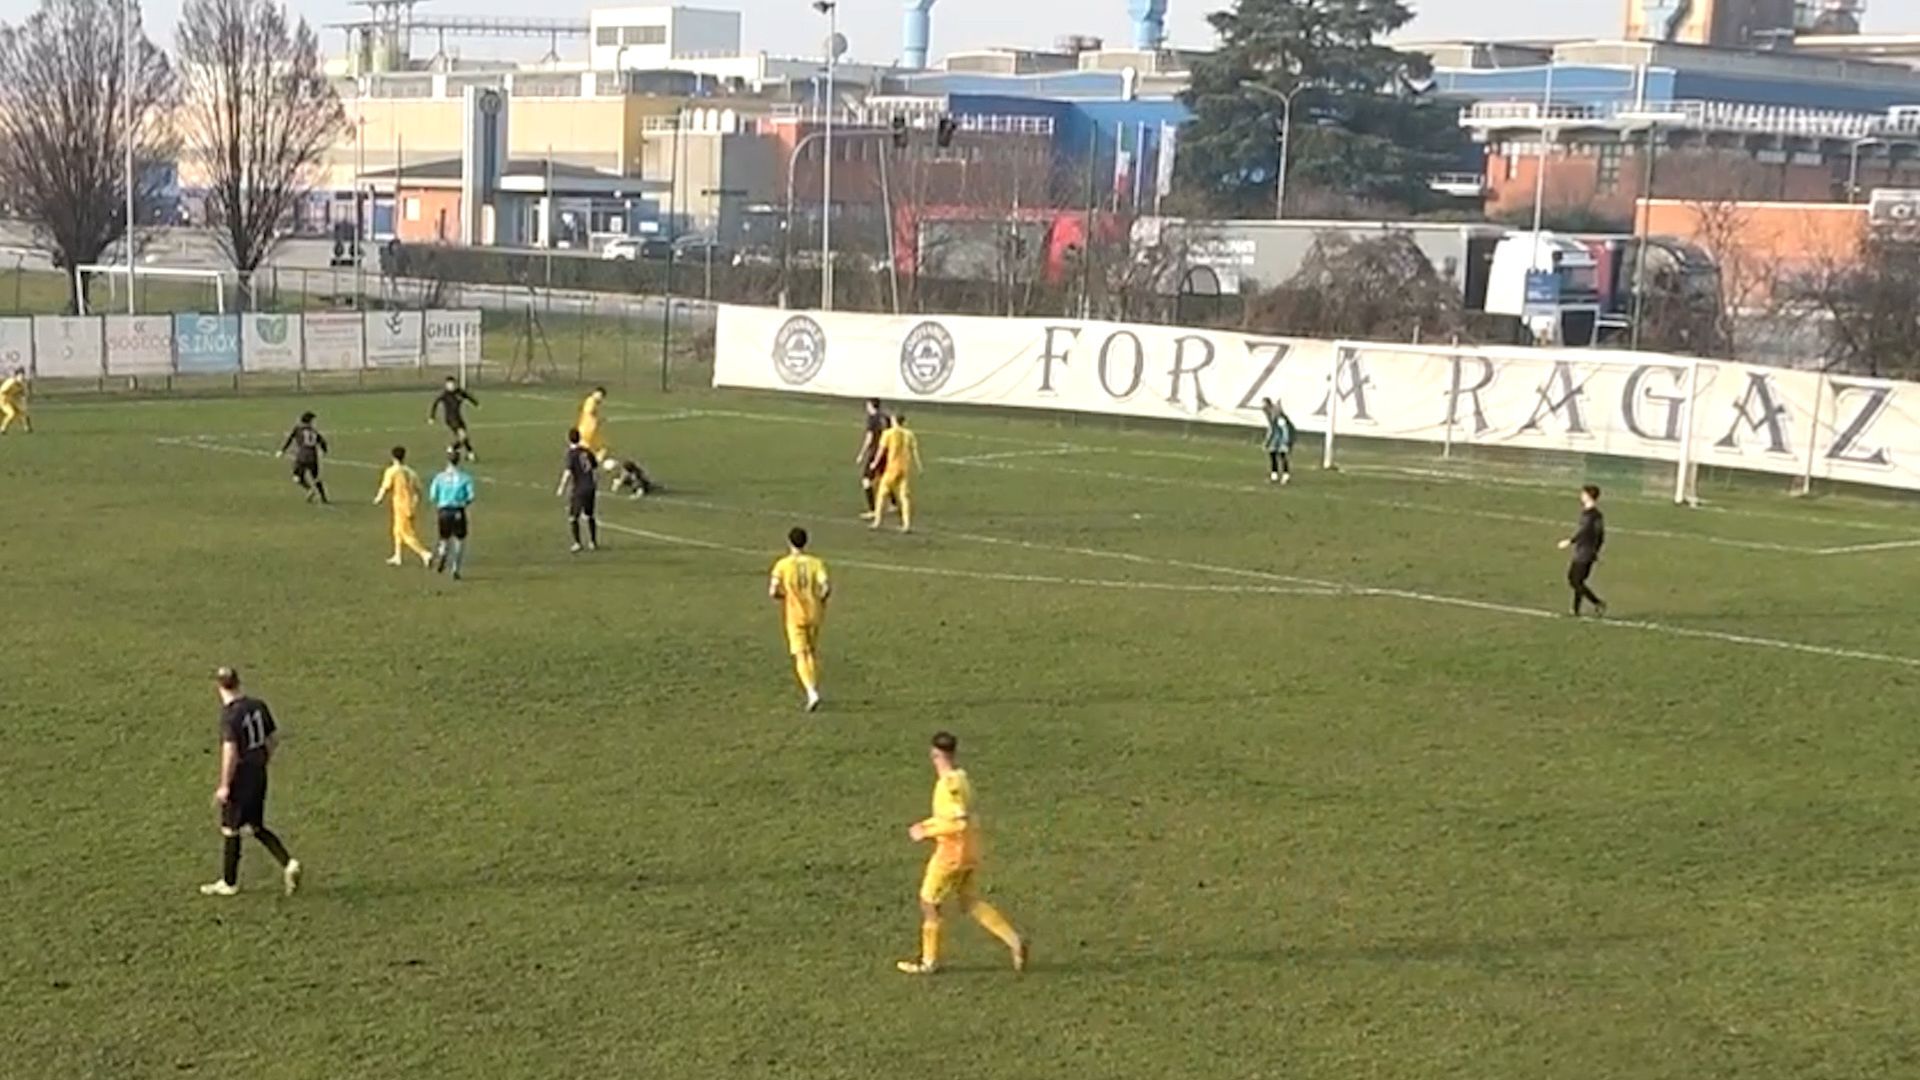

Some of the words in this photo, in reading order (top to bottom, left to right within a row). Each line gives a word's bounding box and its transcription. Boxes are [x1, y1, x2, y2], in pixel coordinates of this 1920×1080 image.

[1036, 325, 1374, 421] FORZA
[1440, 355, 1896, 468] RAGAZ
[242, 709, 265, 749] 11
